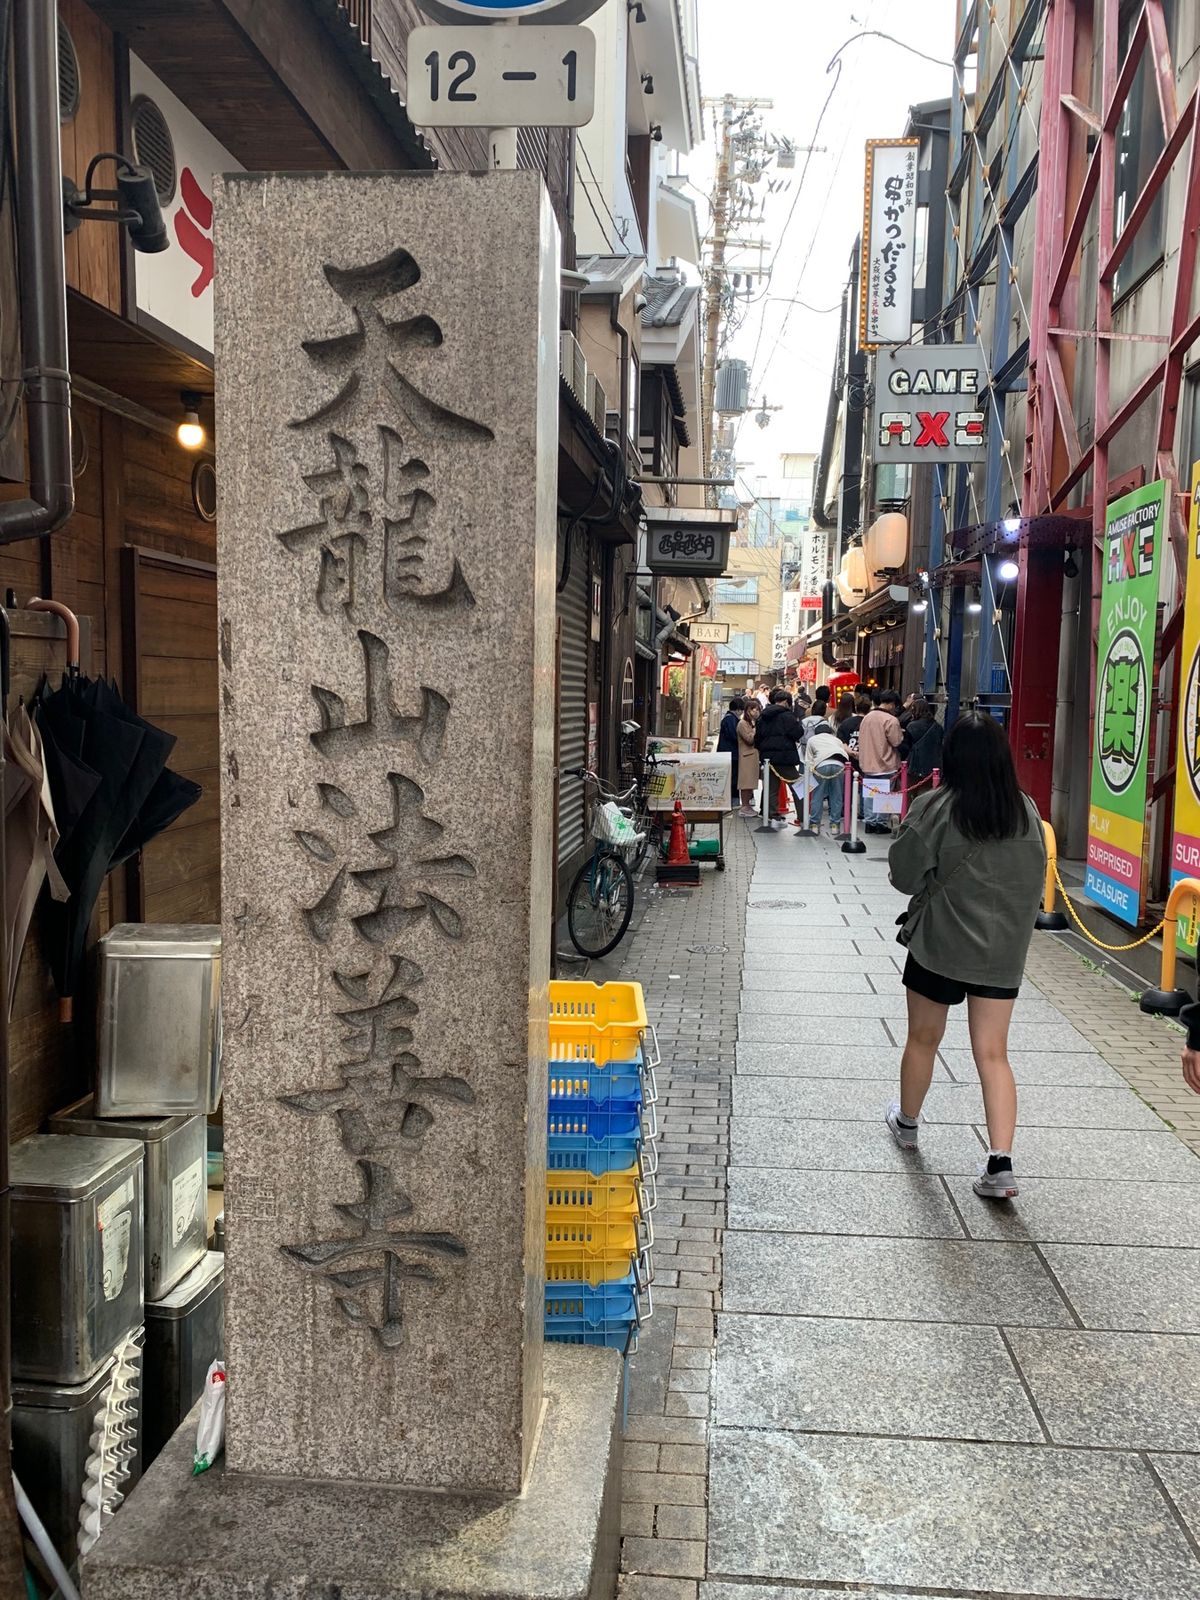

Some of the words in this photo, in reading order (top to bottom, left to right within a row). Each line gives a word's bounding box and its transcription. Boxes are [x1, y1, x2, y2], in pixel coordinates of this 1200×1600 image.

[881, 174, 906, 308] 串かつだるま
[889, 368, 978, 396] GAME
[880, 411, 985, 447] AXE
[1107, 515, 1128, 539] AMUSE
[1128, 500, 1161, 528] FACTORY
[1107, 522, 1155, 584] AXE
[696, 627, 720, 639] BAR
[1107, 595, 1147, 638] ENJOY
[276, 246, 495, 1351] 天龍山法善寺
[1090, 813, 1110, 834] PLAY
[1089, 844, 1133, 878] SURPRISED
[1175, 843, 1200, 868] SUR
[1087, 872, 1129, 911] PLEASURE
